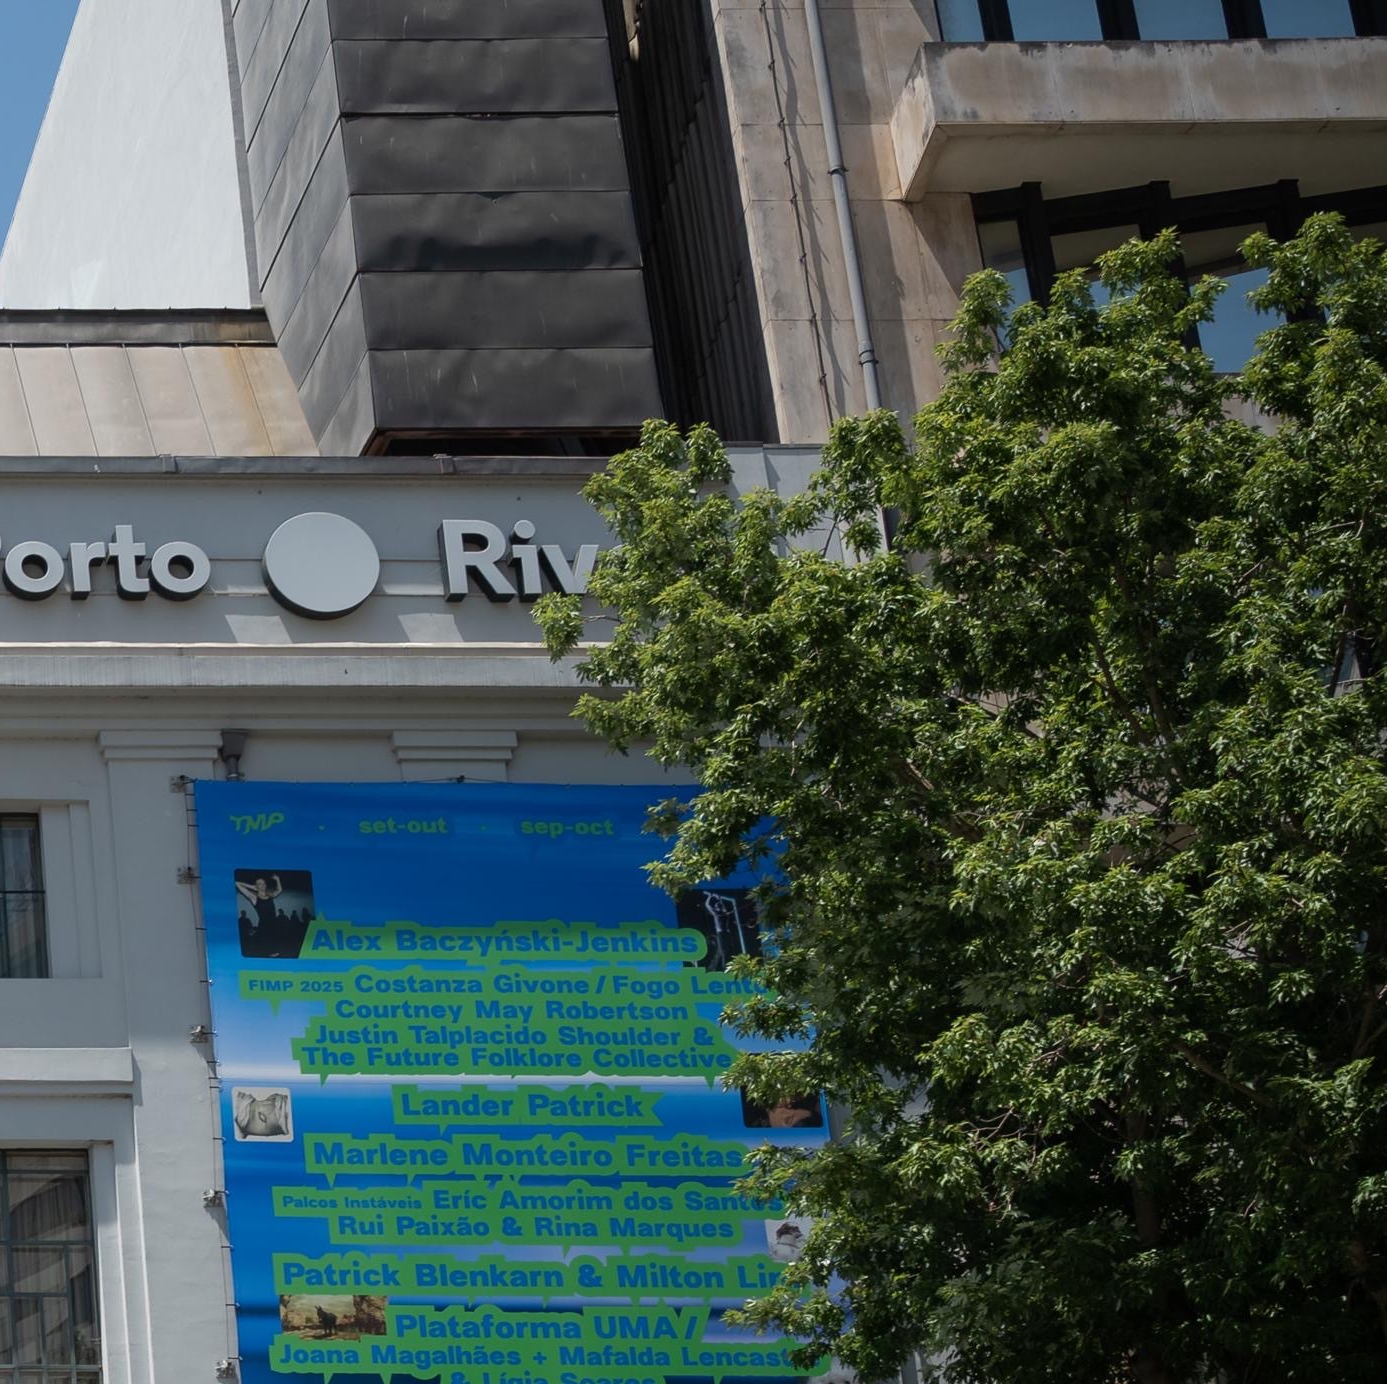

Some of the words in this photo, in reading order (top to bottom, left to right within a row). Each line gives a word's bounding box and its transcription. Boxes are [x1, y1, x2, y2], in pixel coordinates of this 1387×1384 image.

[438, 519, 603, 602] Riv
[229, 812, 284, 834] TMP
[359, 816, 448, 834] set-out
[521, 818, 614, 838] sep-oct
[312, 930, 381, 951] Alex
[395, 926, 697, 956] Baczyński-Jenkins
[249, 980, 292, 990] FIMP
[302, 981, 342, 992] 2025
[355, 974, 482, 992] Costanza
[494, 974, 588, 994] Givone
[613, 976, 680, 999] Fogo
[336, 999, 462, 1023] Courtney
[475, 1000, 532, 1024] May
[546, 1000, 688, 1020] Robertson
[317, 1024, 398, 1044] Justin
[410, 1024, 547, 1049] Talplacido
[559, 1026, 679, 1046] Shoulder
[694, 1027, 713, 1046] &
[303, 1047, 355, 1066] The
[368, 1047, 458, 1066] Future
[471, 1047, 581, 1067] Folklore
[593, 1048, 731, 1068] Collective
[402, 1093, 512, 1116] Lander
[529, 1093, 642, 1117] Patrick
[314, 1143, 448, 1166] Marlene
[463, 1143, 613, 1167] Monteiro
[627, 1143, 742, 1167] Freitas
[283, 1197, 337, 1208] Palcos
[345, 1195, 420, 1208] Instáveis
[500, 1191, 612, 1210] Amorim
[625, 1192, 672, 1211] dos
[339, 1215, 384, 1235] Rui
[397, 1216, 489, 1236] Paixão
[502, 1216, 522, 1236] &
[535, 1216, 598, 1236] Rina
[610, 1218, 733, 1242] Marques
[283, 1261, 399, 1286] Patrick
[416, 1263, 563, 1287] Blenkarn
[579, 1264, 602, 1287] &
[618, 1265, 723, 1288] Milton
[738, 1263, 801, 1289] Li
[396, 1314, 582, 1339] Plataforma
[282, 1345, 359, 1363] Joana
[372, 1344, 520, 1370] Magalhães
[533, 1352, 548, 1366] +
[559, 1345, 670, 1365] Mafalda
[682, 1347, 819, 1367] Lencast
